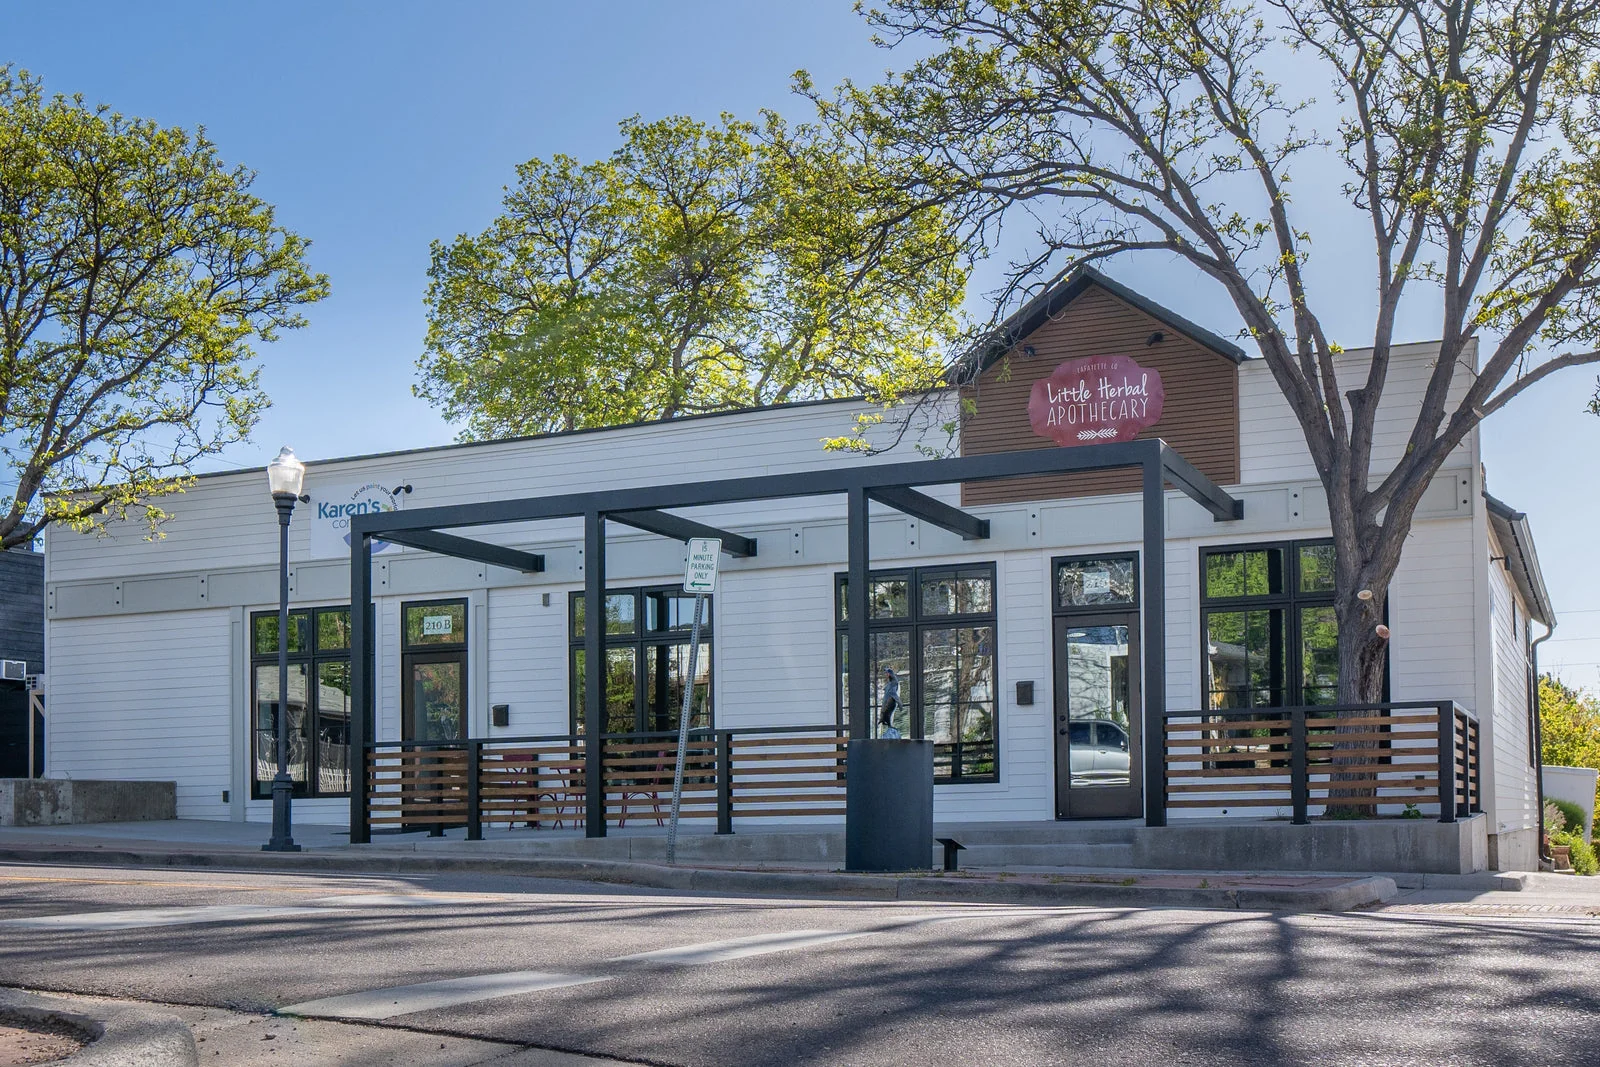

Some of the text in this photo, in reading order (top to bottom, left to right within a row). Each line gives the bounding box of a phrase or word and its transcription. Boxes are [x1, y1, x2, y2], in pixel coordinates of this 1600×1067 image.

[1076, 362, 1107, 373] LAFAYETTE
[1047, 373, 1149, 404] Little Herbal
[1046, 397, 1149, 427] APOTHECARY
[350, 490, 360, 500] Let
[318, 498, 380, 519] Karen's
[692, 554, 713, 562] MINUTE
[690, 562, 715, 570] PARKING
[693, 571, 709, 580] ONLY
[425, 619, 451, 631] 210 B
